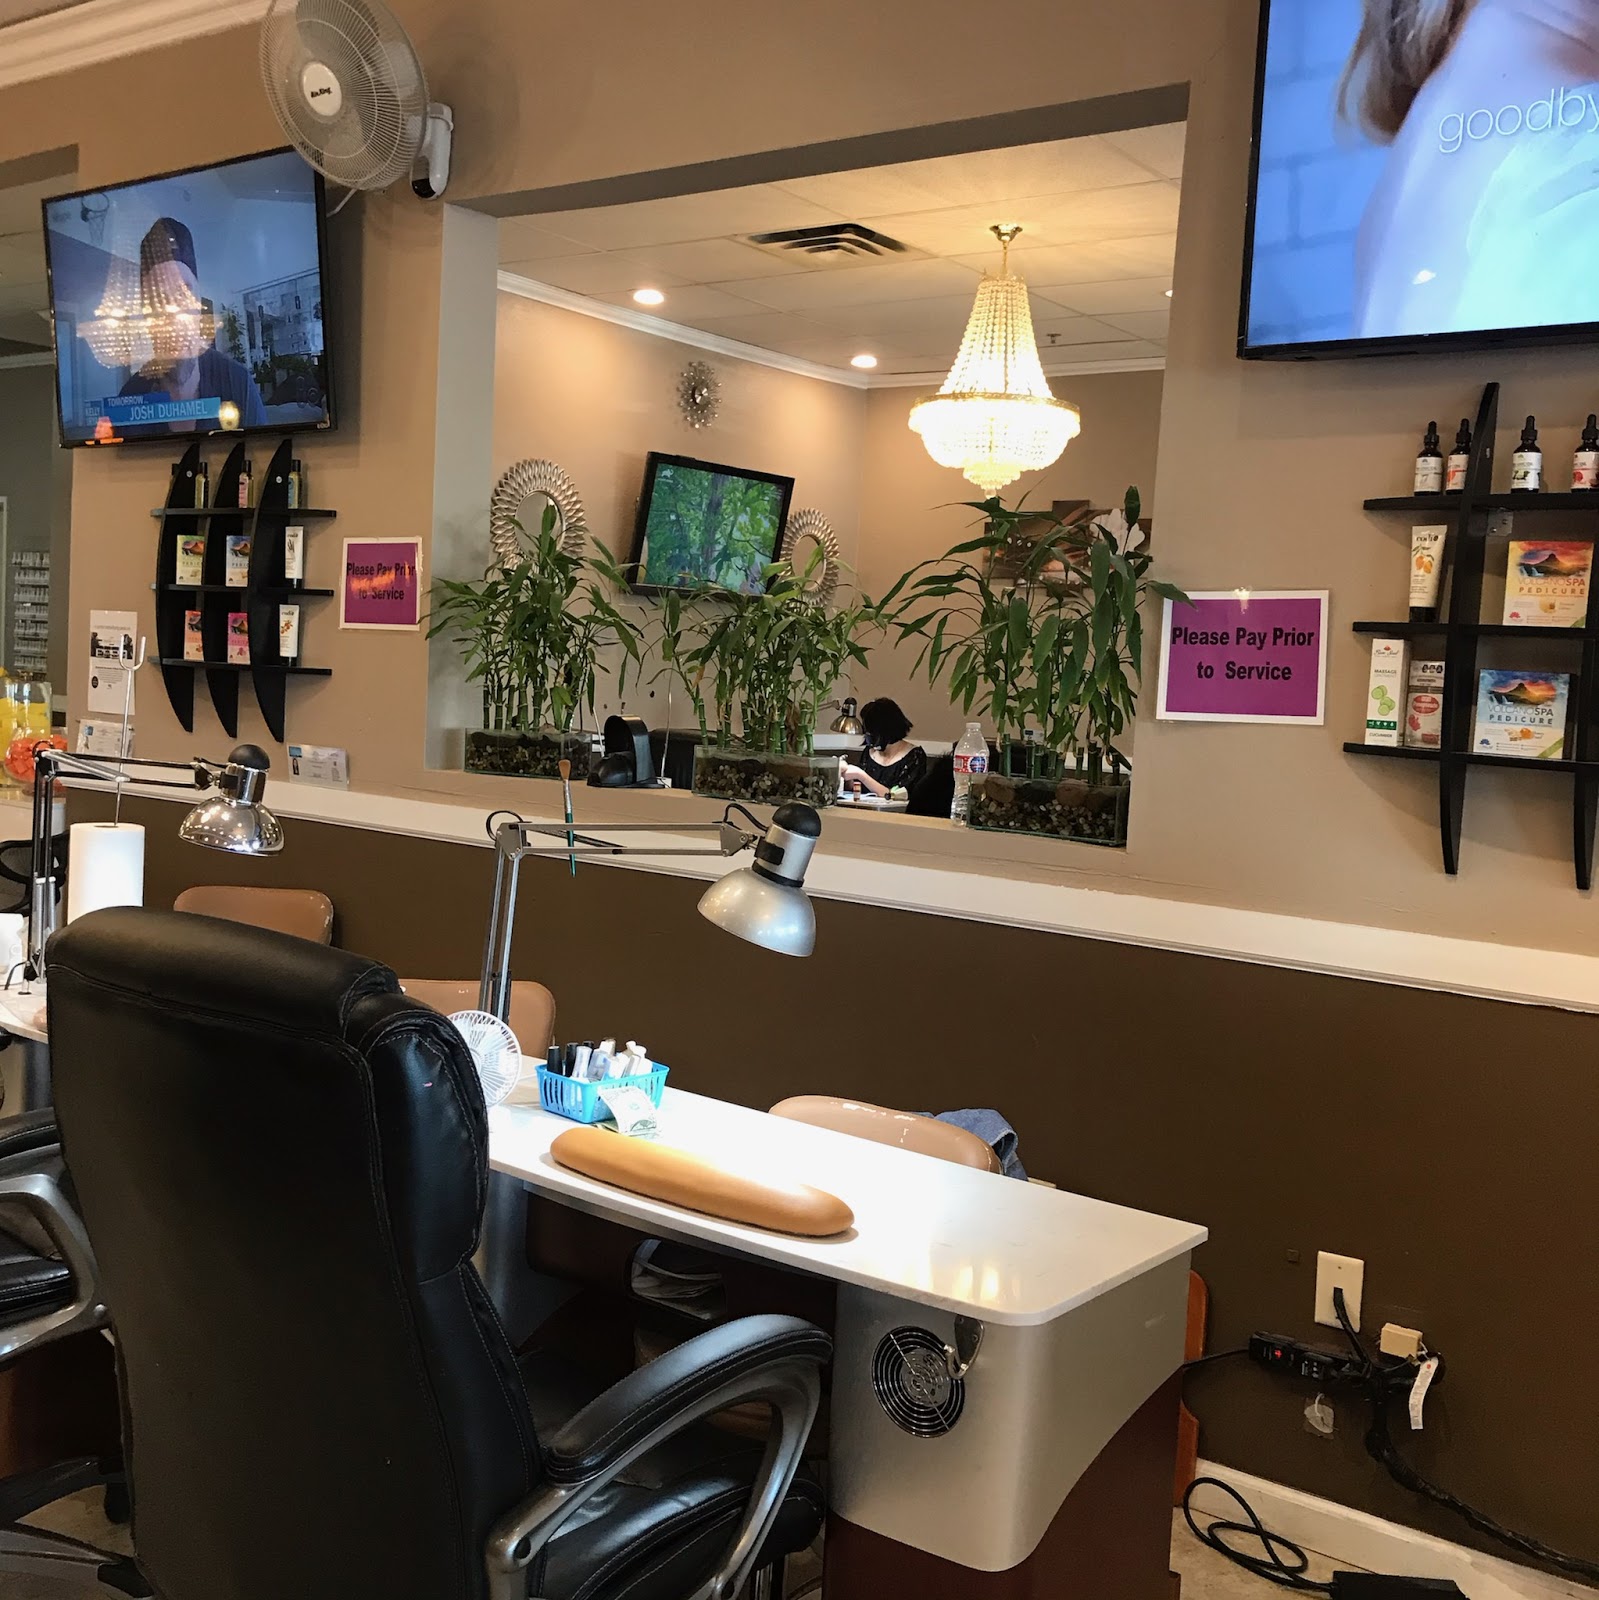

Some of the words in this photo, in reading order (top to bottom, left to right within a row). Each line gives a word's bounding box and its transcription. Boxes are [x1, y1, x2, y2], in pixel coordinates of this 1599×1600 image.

[1438, 86, 1599, 153] goodby
[129, 404, 155, 421] JOSH
[158, 400, 208, 418] DUHAMEL
[346, 562, 375, 576] Please
[377, 562, 393, 578] Pay
[371, 586, 405, 600] Service
[1519, 586, 1585, 595] PEDICURE
[1171, 626, 1230, 646] Please
[1235, 627, 1267, 651] Pay
[1272, 627, 1315, 646] Prior
[1196, 661, 1214, 679] to
[1225, 661, 1292, 681] Service
[1489, 714, 1553, 725] PEDICURE
